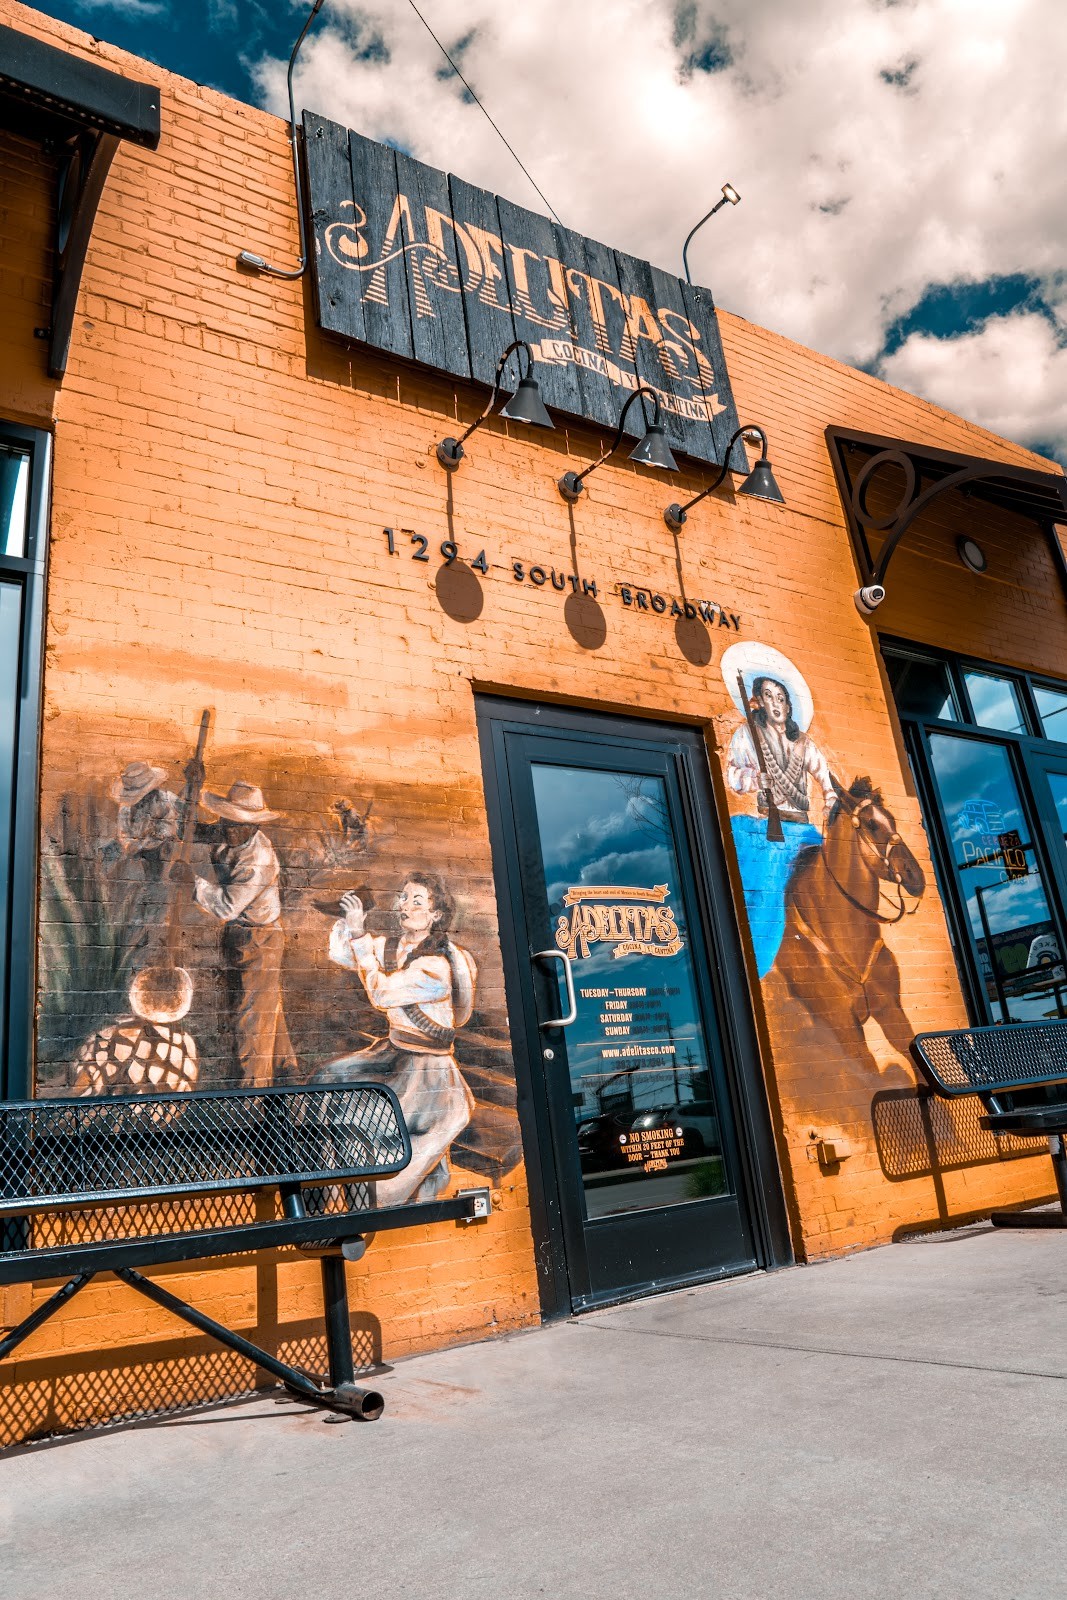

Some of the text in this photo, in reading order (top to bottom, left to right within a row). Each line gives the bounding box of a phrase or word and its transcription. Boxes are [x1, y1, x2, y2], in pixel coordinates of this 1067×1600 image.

[325, 193, 716, 390] ADELITAS
[552, 342, 609, 375] COCINA
[625, 373, 635, 388] Y
[382, 527, 742, 632] 1294 SOUTH BROADWAY
[555, 905, 680, 960] ADELITAS
[605, 1001, 627, 1010] FRIDAY
[600, 1013, 632, 1023] SATURDAY
[605, 1026, 630, 1036] SUNDAY
[602, 1045, 676, 1058] www.adelitasco.com
[629, 1128, 674, 1143] NO SMOKING
[620, 1138, 685, 1154] WITHIN 20 FEET OF THE
[628, 1152, 643, 1162] DOOR
[650, 1148, 670, 1159] THANK
[669, 1147, 680, 1156] YOU
